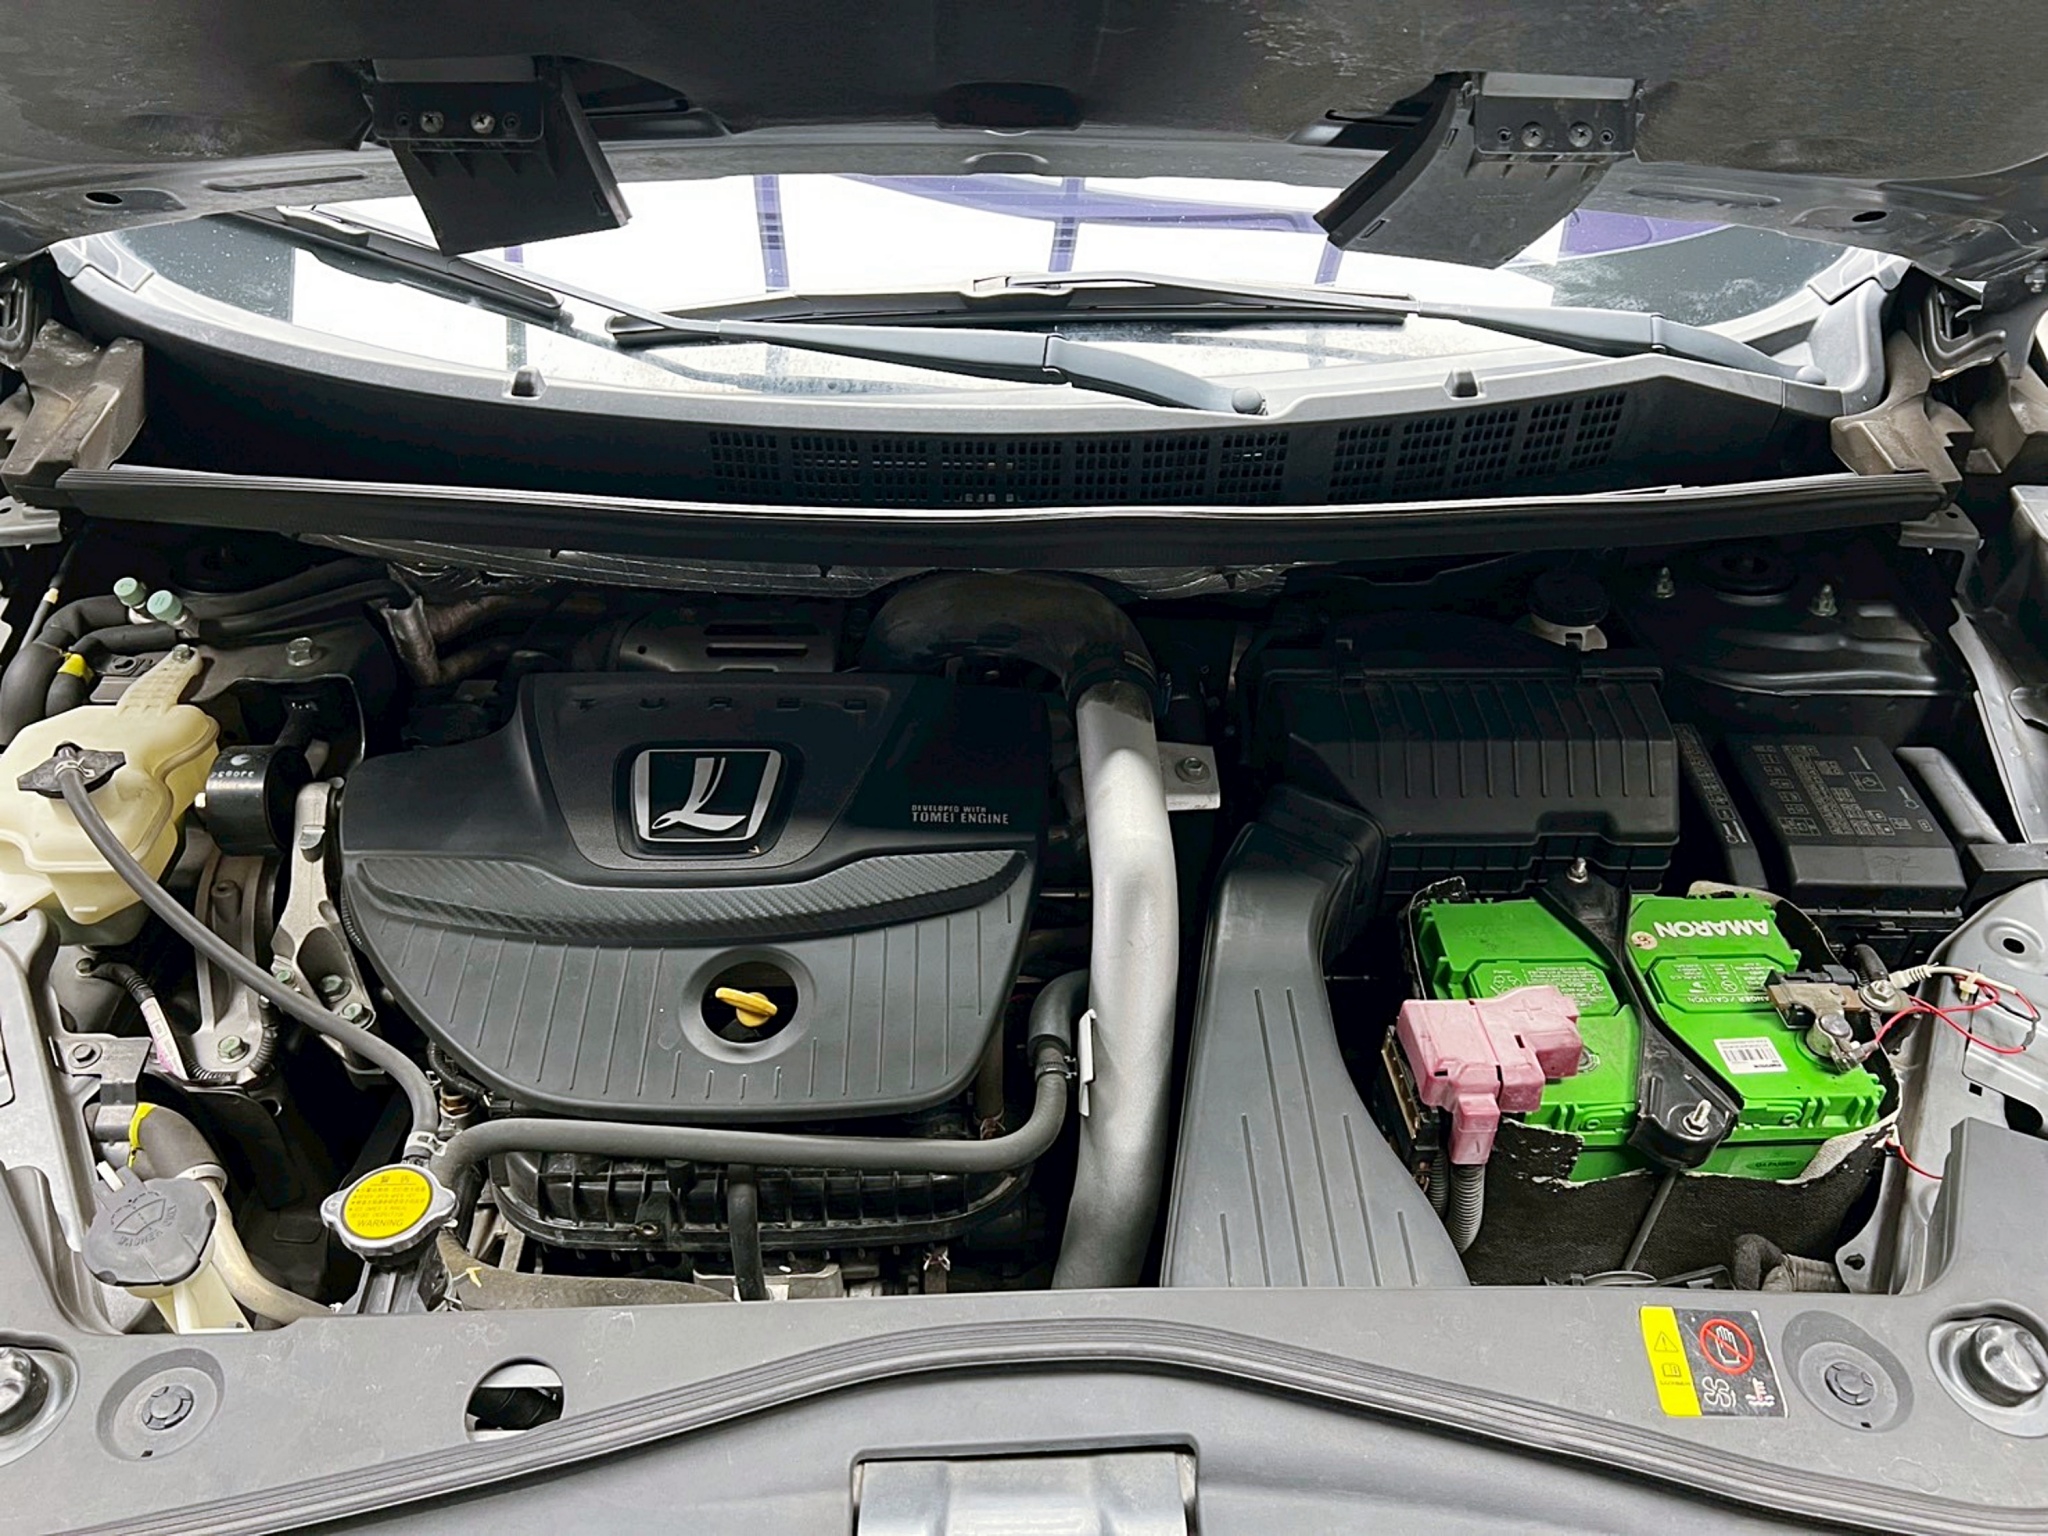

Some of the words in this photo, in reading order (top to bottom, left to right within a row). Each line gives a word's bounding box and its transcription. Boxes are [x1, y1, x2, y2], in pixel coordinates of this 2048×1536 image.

[911, 804, 960, 813] DEVELOPED
[912, 811, 955, 823] TOMEI
[960, 813, 1009, 825] ENGINE
[1653, 919, 1769, 938] AMARON
[1737, 995, 1770, 1003] ANGER
[357, 1219, 403, 1227] WARNING
